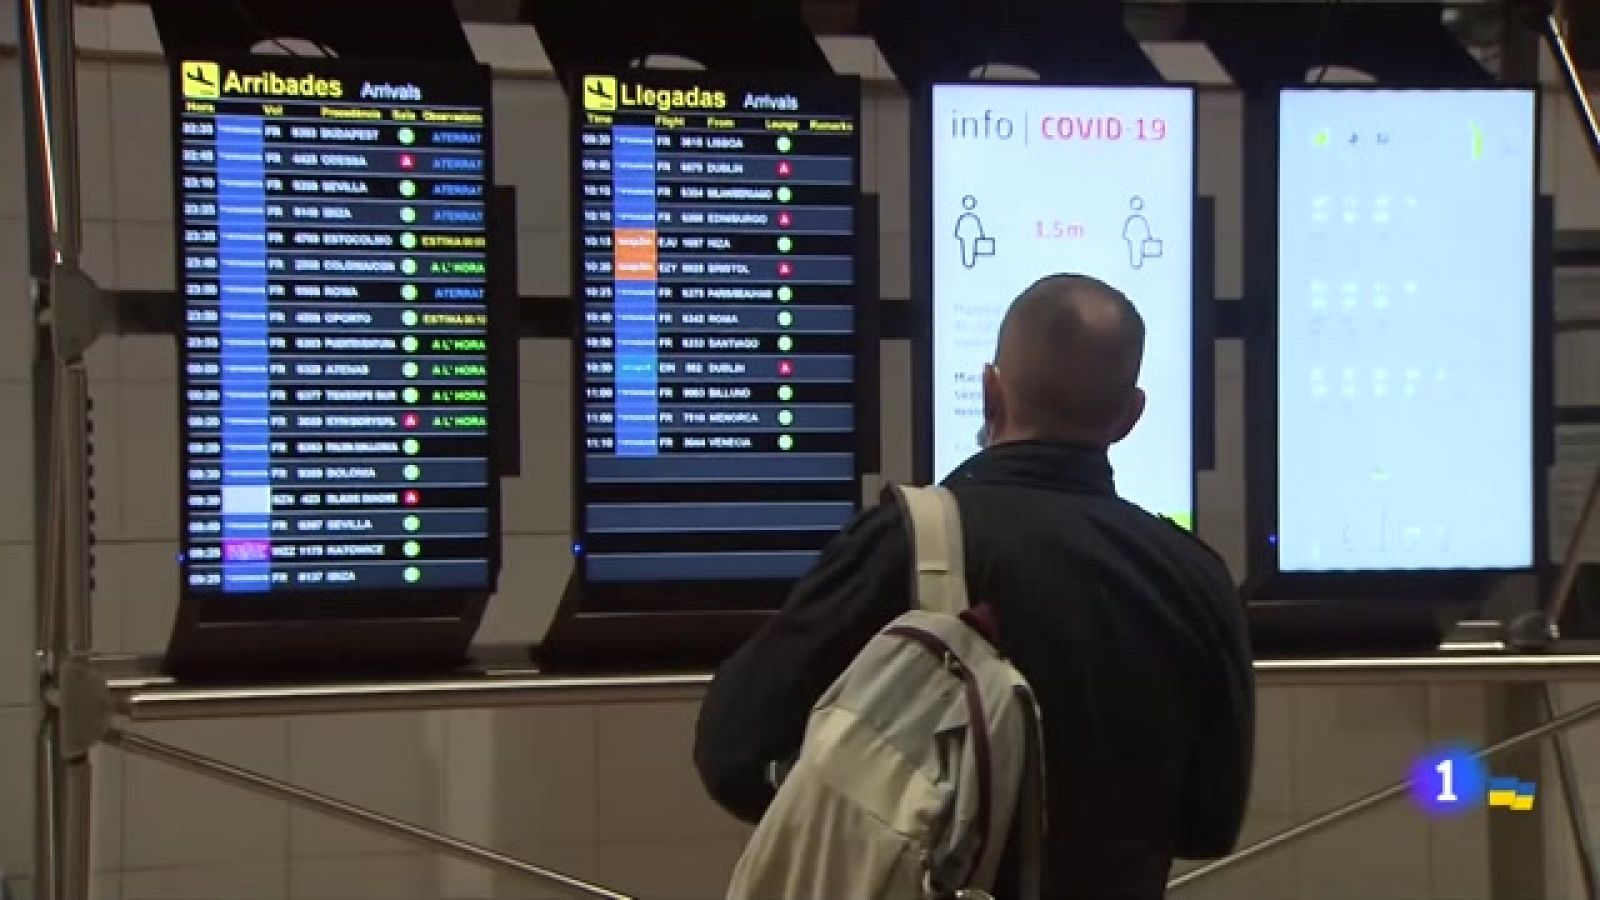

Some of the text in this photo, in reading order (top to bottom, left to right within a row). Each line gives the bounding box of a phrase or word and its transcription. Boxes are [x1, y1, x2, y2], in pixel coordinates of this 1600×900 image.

[224, 70, 342, 97] Arribades
[360, 82, 422, 100] Arrivals
[620, 83, 726, 110] Llegadas
[743, 93, 798, 110] Arrivals
[263, 105, 283, 116] Vol
[587, 113, 613, 124] Time
[655, 116, 685, 128] Flight
[707, 117, 735, 128] From
[951, 110, 1014, 139] info
